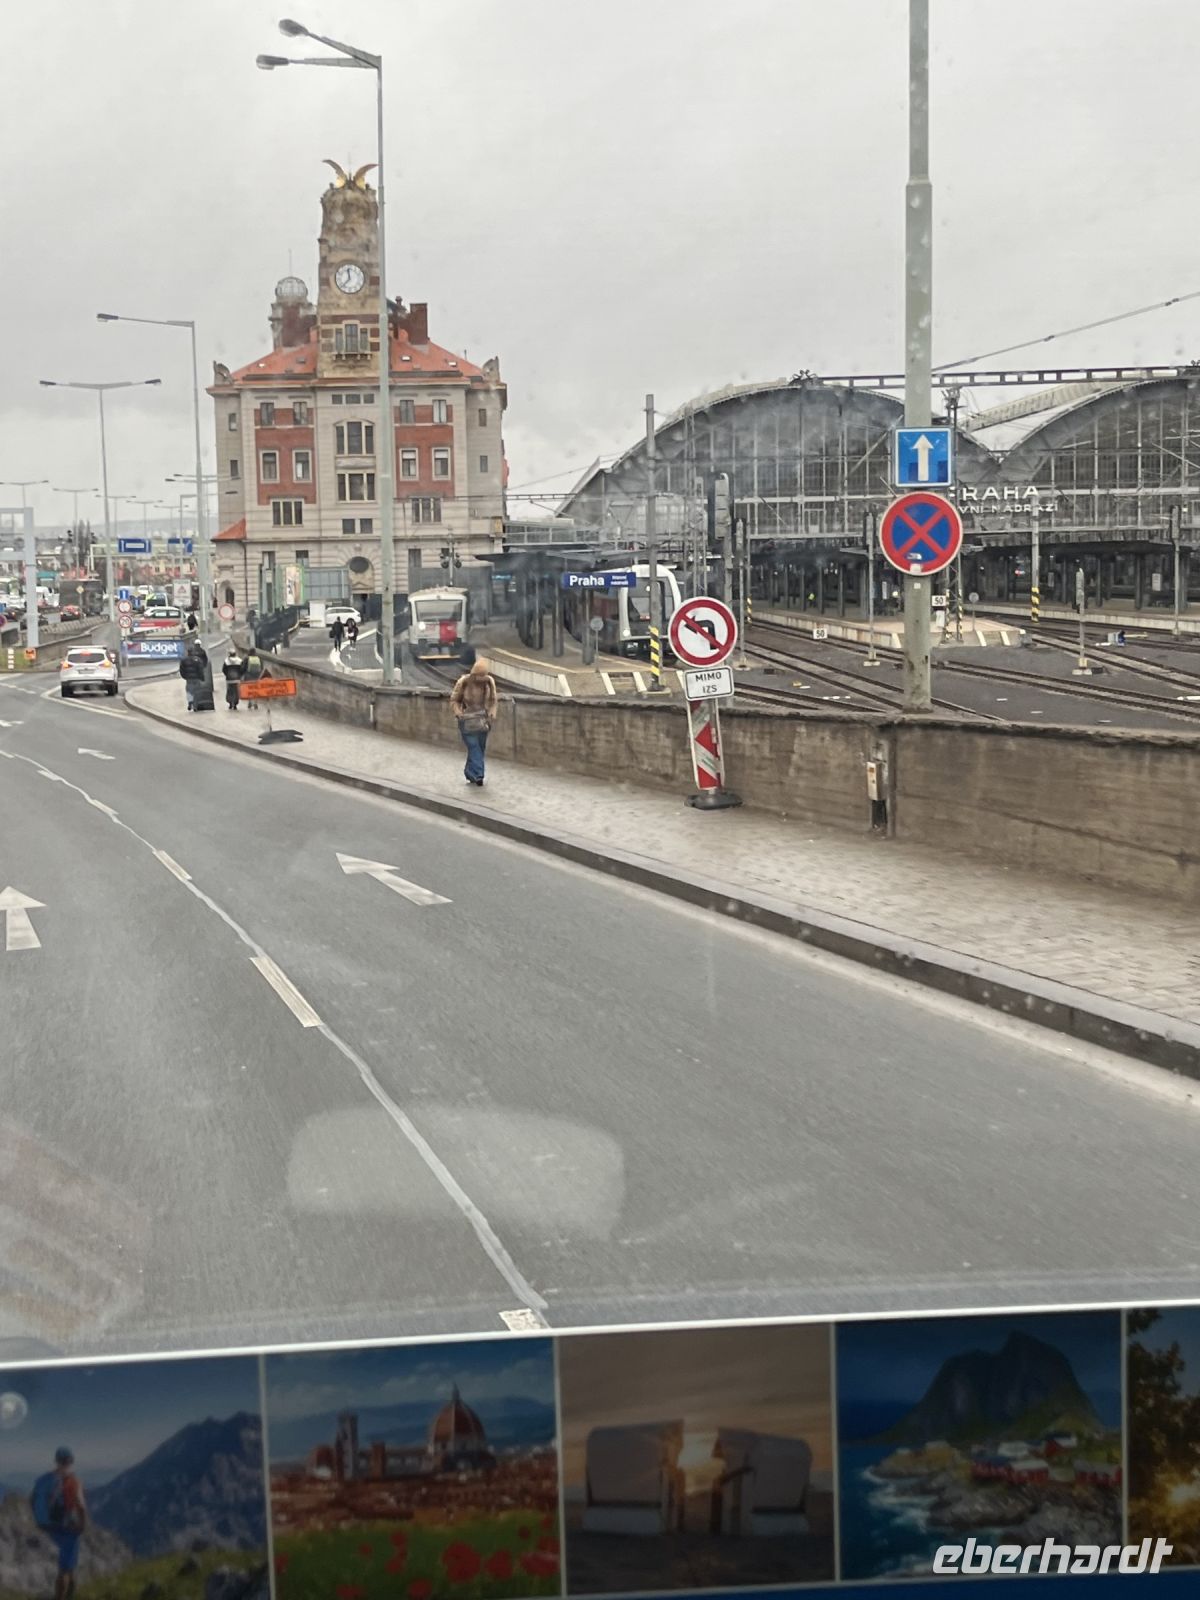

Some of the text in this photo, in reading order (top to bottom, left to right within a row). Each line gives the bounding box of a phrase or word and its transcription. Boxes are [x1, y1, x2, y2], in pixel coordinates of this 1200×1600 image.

[569, 575, 605, 586] Praha
[934, 596, 944, 605] 50
[816, 630, 825, 638] 50
[140, 642, 178, 655] Budget
[695, 671, 722, 682] MIMO
[702, 684, 718, 694] IZS
